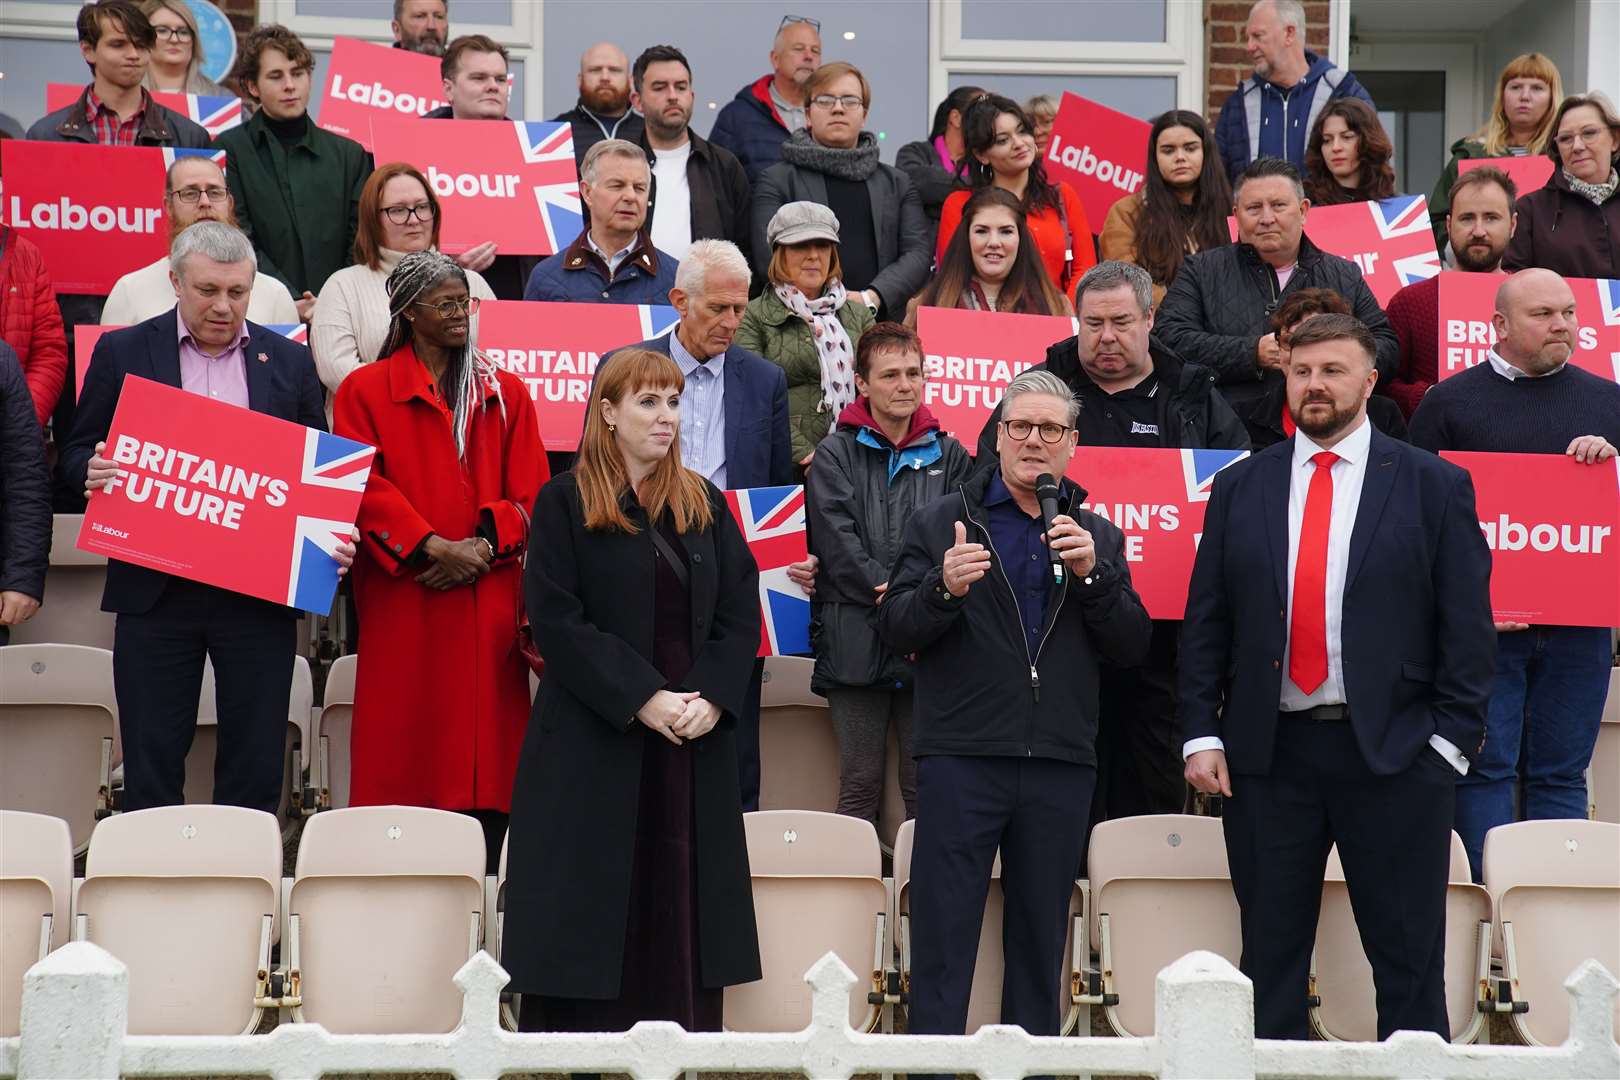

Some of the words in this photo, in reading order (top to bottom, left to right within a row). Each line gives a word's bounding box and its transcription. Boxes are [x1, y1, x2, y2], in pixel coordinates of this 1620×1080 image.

[330, 74, 451, 117] Labou
[422, 166, 521, 198] bour
[1048, 135, 1144, 193] Labour
[10, 195, 162, 233] Labour
[924, 382, 1007, 409] FUTU
[112, 433, 289, 507] BRITAIN'S
[103, 469, 246, 530] FUTURE
[100, 524, 130, 539] Labour
[1478, 513, 1611, 554] abour
